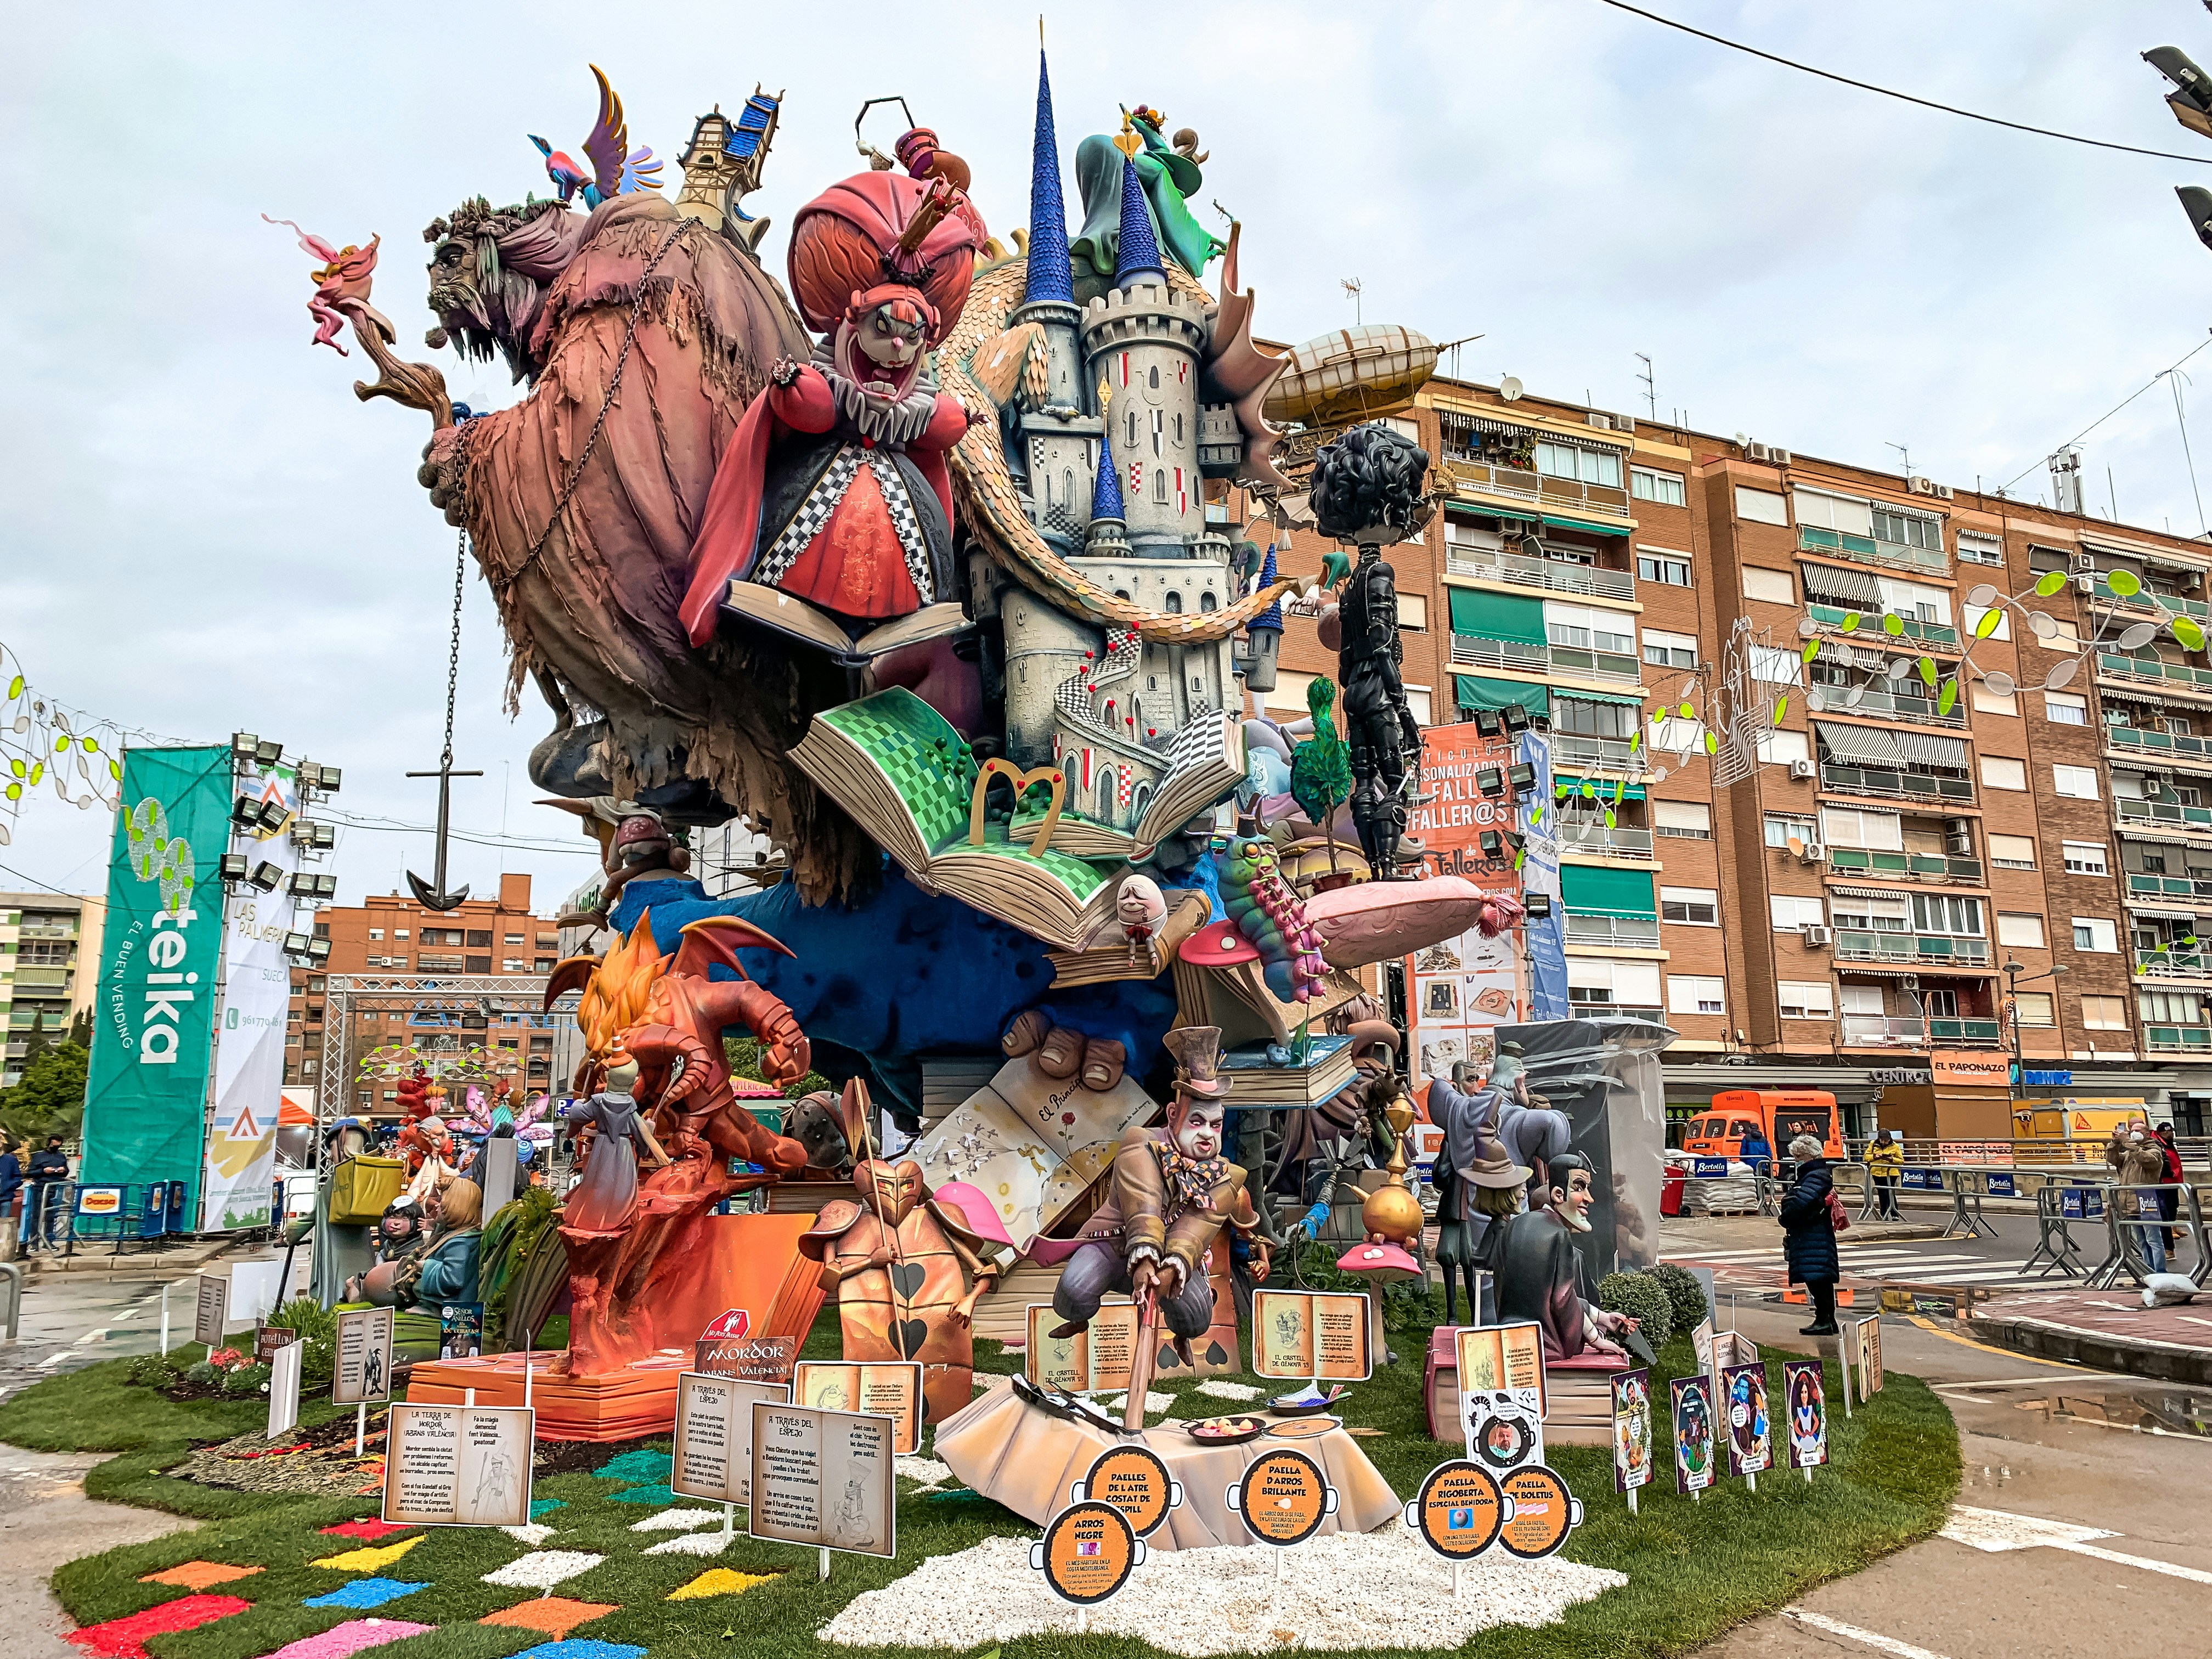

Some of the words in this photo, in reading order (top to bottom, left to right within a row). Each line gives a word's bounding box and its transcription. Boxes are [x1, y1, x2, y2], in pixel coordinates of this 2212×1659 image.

[1465, 844, 1476, 856] de
[234, 901, 256, 922] LAS
[128, 920, 143, 935] EL
[113, 940, 133, 979] BUEN
[262, 968, 287, 983] SUECA
[140, 910, 198, 1064] teika
[111, 984, 133, 1049] VENDING
[1949, 1063, 2005, 1072] PAPONAZO
[1039, 1105, 1054, 1121] El
[707, 1342, 784, 1361] MORDOR
[697, 1386, 715, 1396] TRAVÉS
[699, 1396, 718, 1404] ESPEJO
[422, 1412, 441, 1420] TERRA
[419, 1421, 447, 1430] MORDOR
[775, 1416, 799, 1428] TRAVÉS
[802, 1419, 813, 1428] DEL
[780, 1428, 803, 1437] ESPEJO
[766, 1454, 785, 1462] Benidorm
[785, 1457, 802, 1465] buscant
[1444, 1478, 1475, 1487] PAELLA
[1262, 1487, 1306, 1496] BRILLANTE
[1438, 1488, 1484, 1498] RIGOBERTA
[1074, 1519, 1104, 1528] ARROS
[1075, 1531, 1103, 1539] NEGRE
